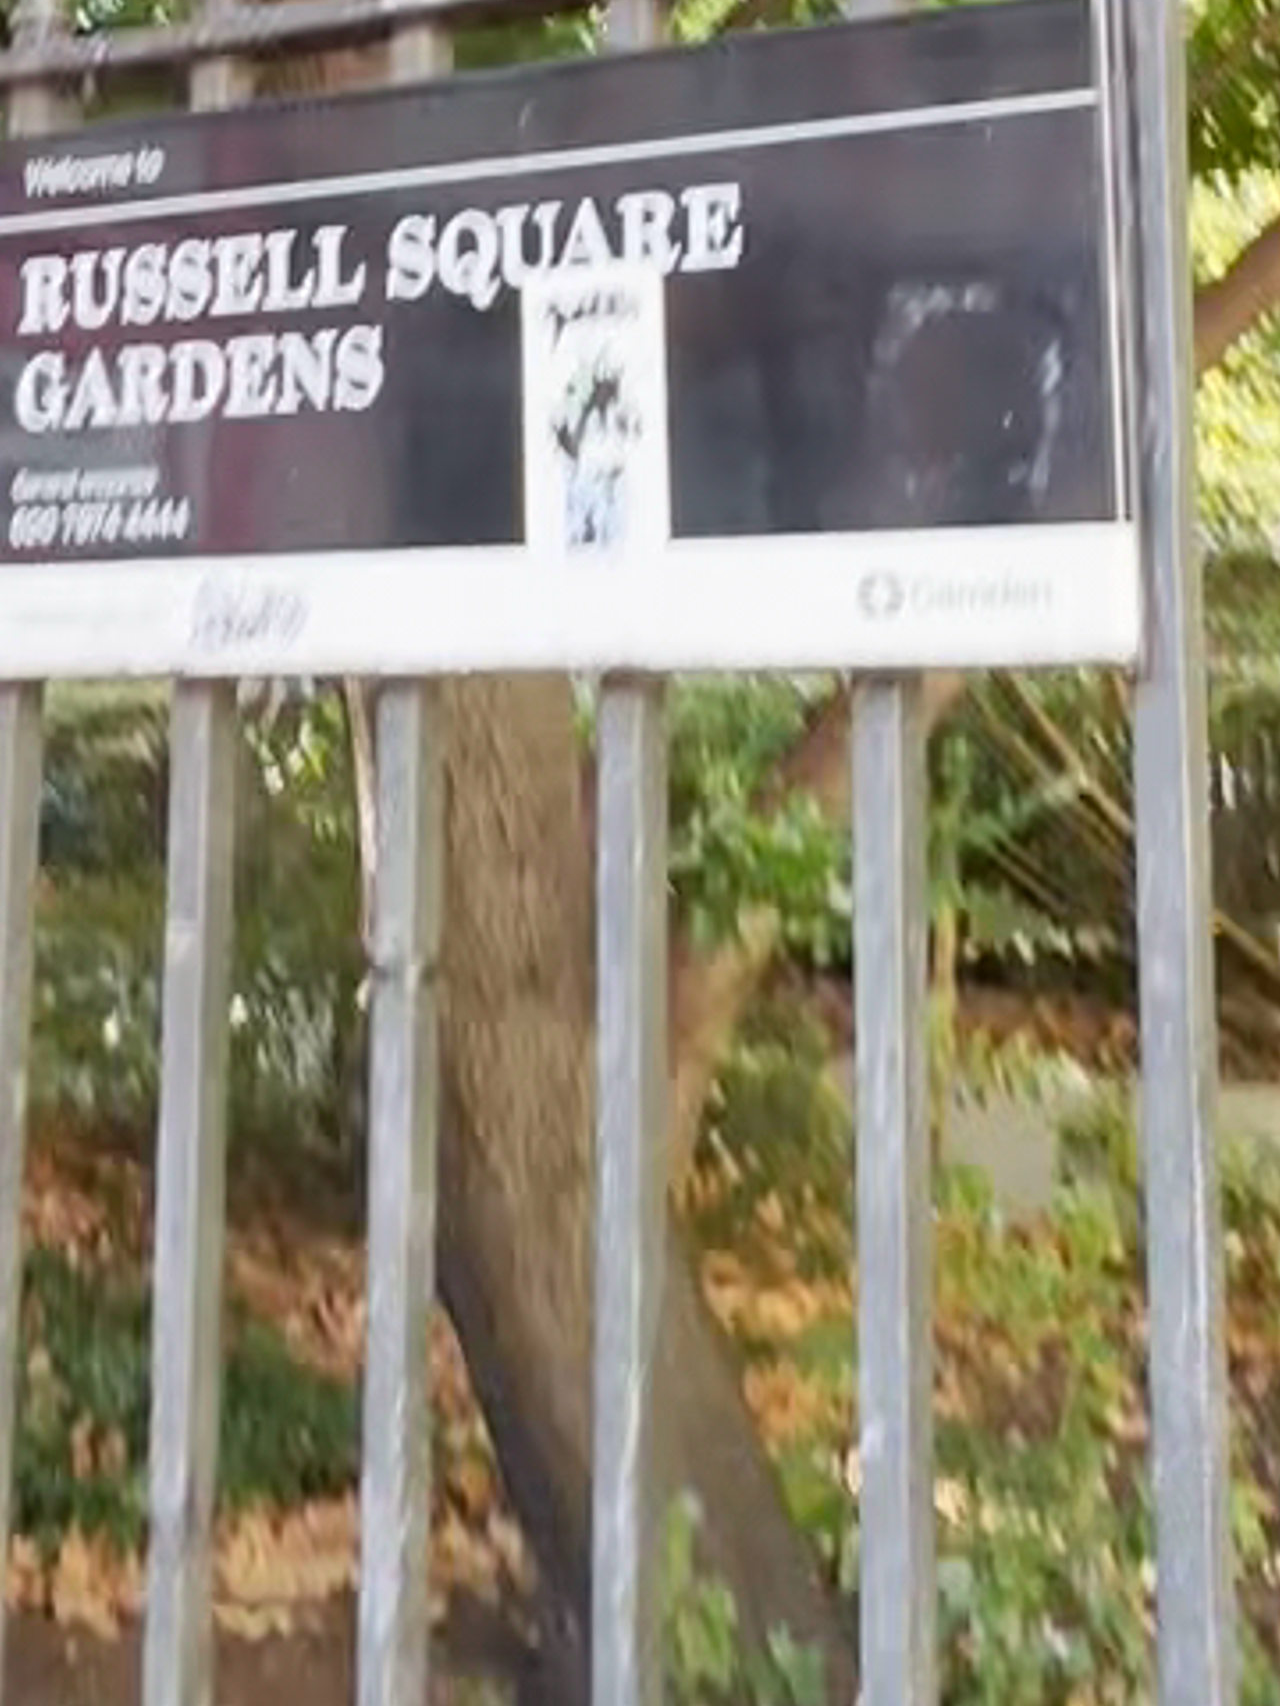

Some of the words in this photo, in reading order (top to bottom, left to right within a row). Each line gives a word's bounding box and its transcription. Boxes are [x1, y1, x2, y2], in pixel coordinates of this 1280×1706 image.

[24, 153, 134, 198] Welcome
[136, 143, 165, 184] to
[16, 224, 367, 335] RUSSELL
[386, 182, 744, 311] SQUARE
[14, 323, 384, 433] GARDENS
